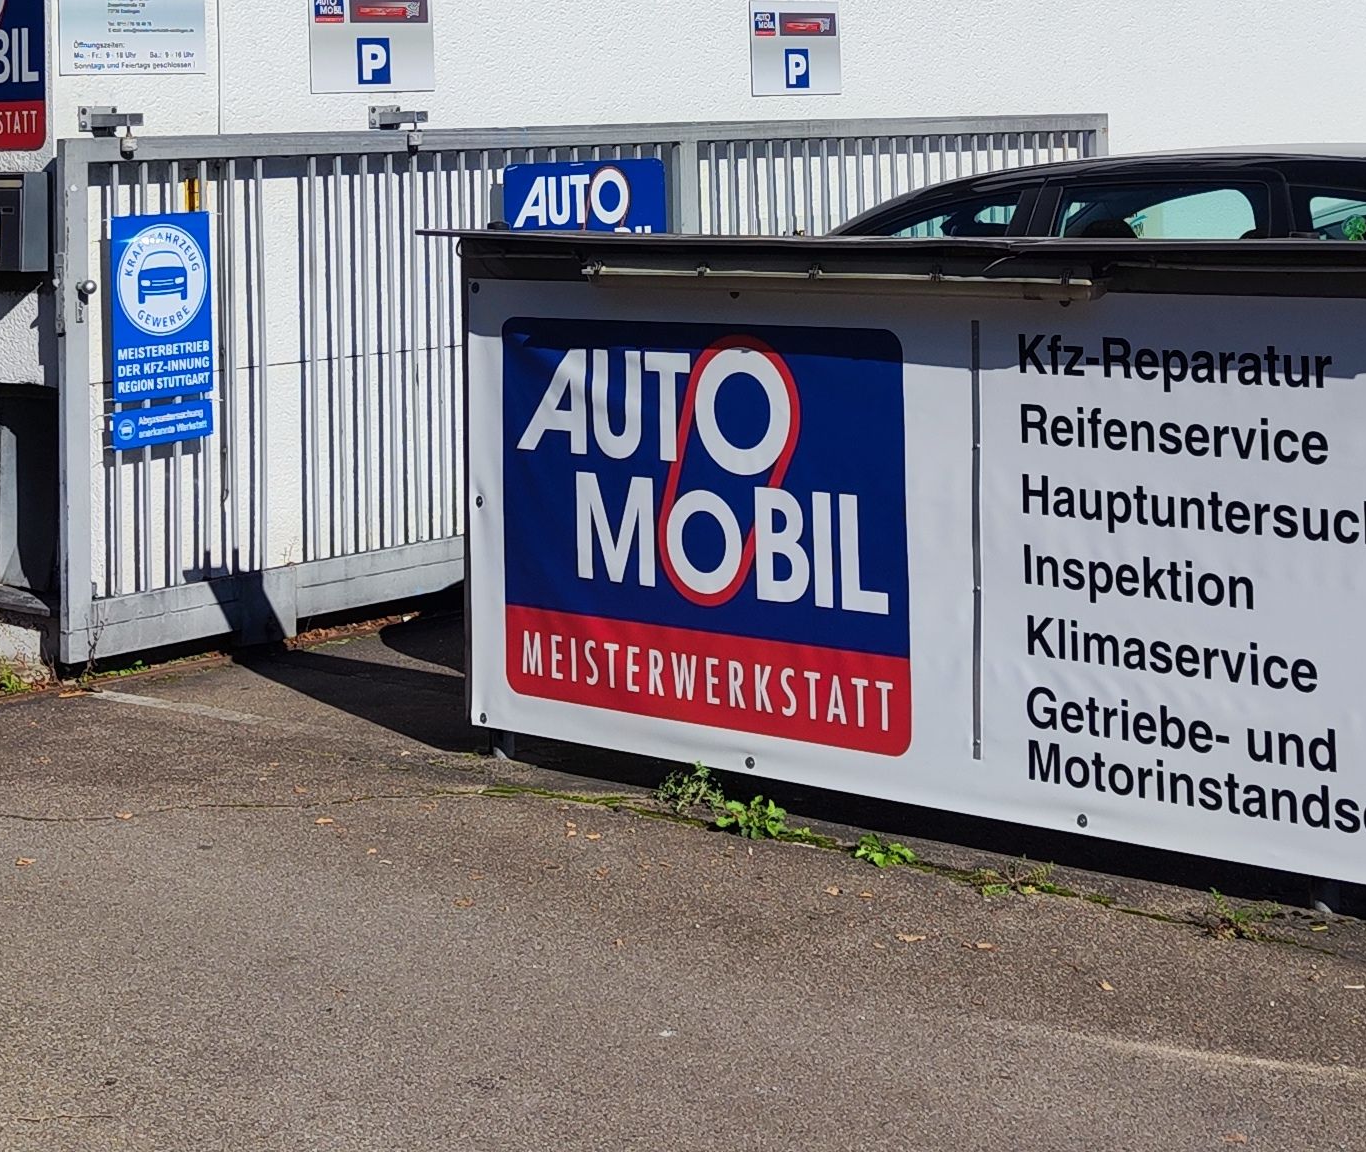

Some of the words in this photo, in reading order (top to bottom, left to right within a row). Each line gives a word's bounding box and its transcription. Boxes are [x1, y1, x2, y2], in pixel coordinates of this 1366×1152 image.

[320, 6, 343, 15] MOBIL
[361, 44, 387, 81] P
[788, 53, 807, 85] P
[513, 168, 629, 228] AUTO
[124, 232, 201, 277] KRAFAHRZEUG
[137, 305, 191, 327] GEWERBE
[118, 340, 210, 361] MEISTERBETRIEB
[118, 364, 141, 378] DER
[143, 356, 210, 374] KFZ-INNUNG
[1016, 333, 1334, 393] Kfz-Reparatur
[118, 379, 155, 394] REGION
[156, 372, 211, 389] STUTTGART
[516, 347, 791, 475] AUTO
[1018, 403, 1330, 466] Reifenservice
[575, 470, 890, 616] MOBIL
[1022, 544, 1256, 610] Inspektion
[522, 630, 893, 732] MEISTERWERKSTATT
[1026, 615, 1319, 694] Klimaservice
[1026, 687, 1231, 752] Getriebe-
[1246, 729, 1338, 773] und
